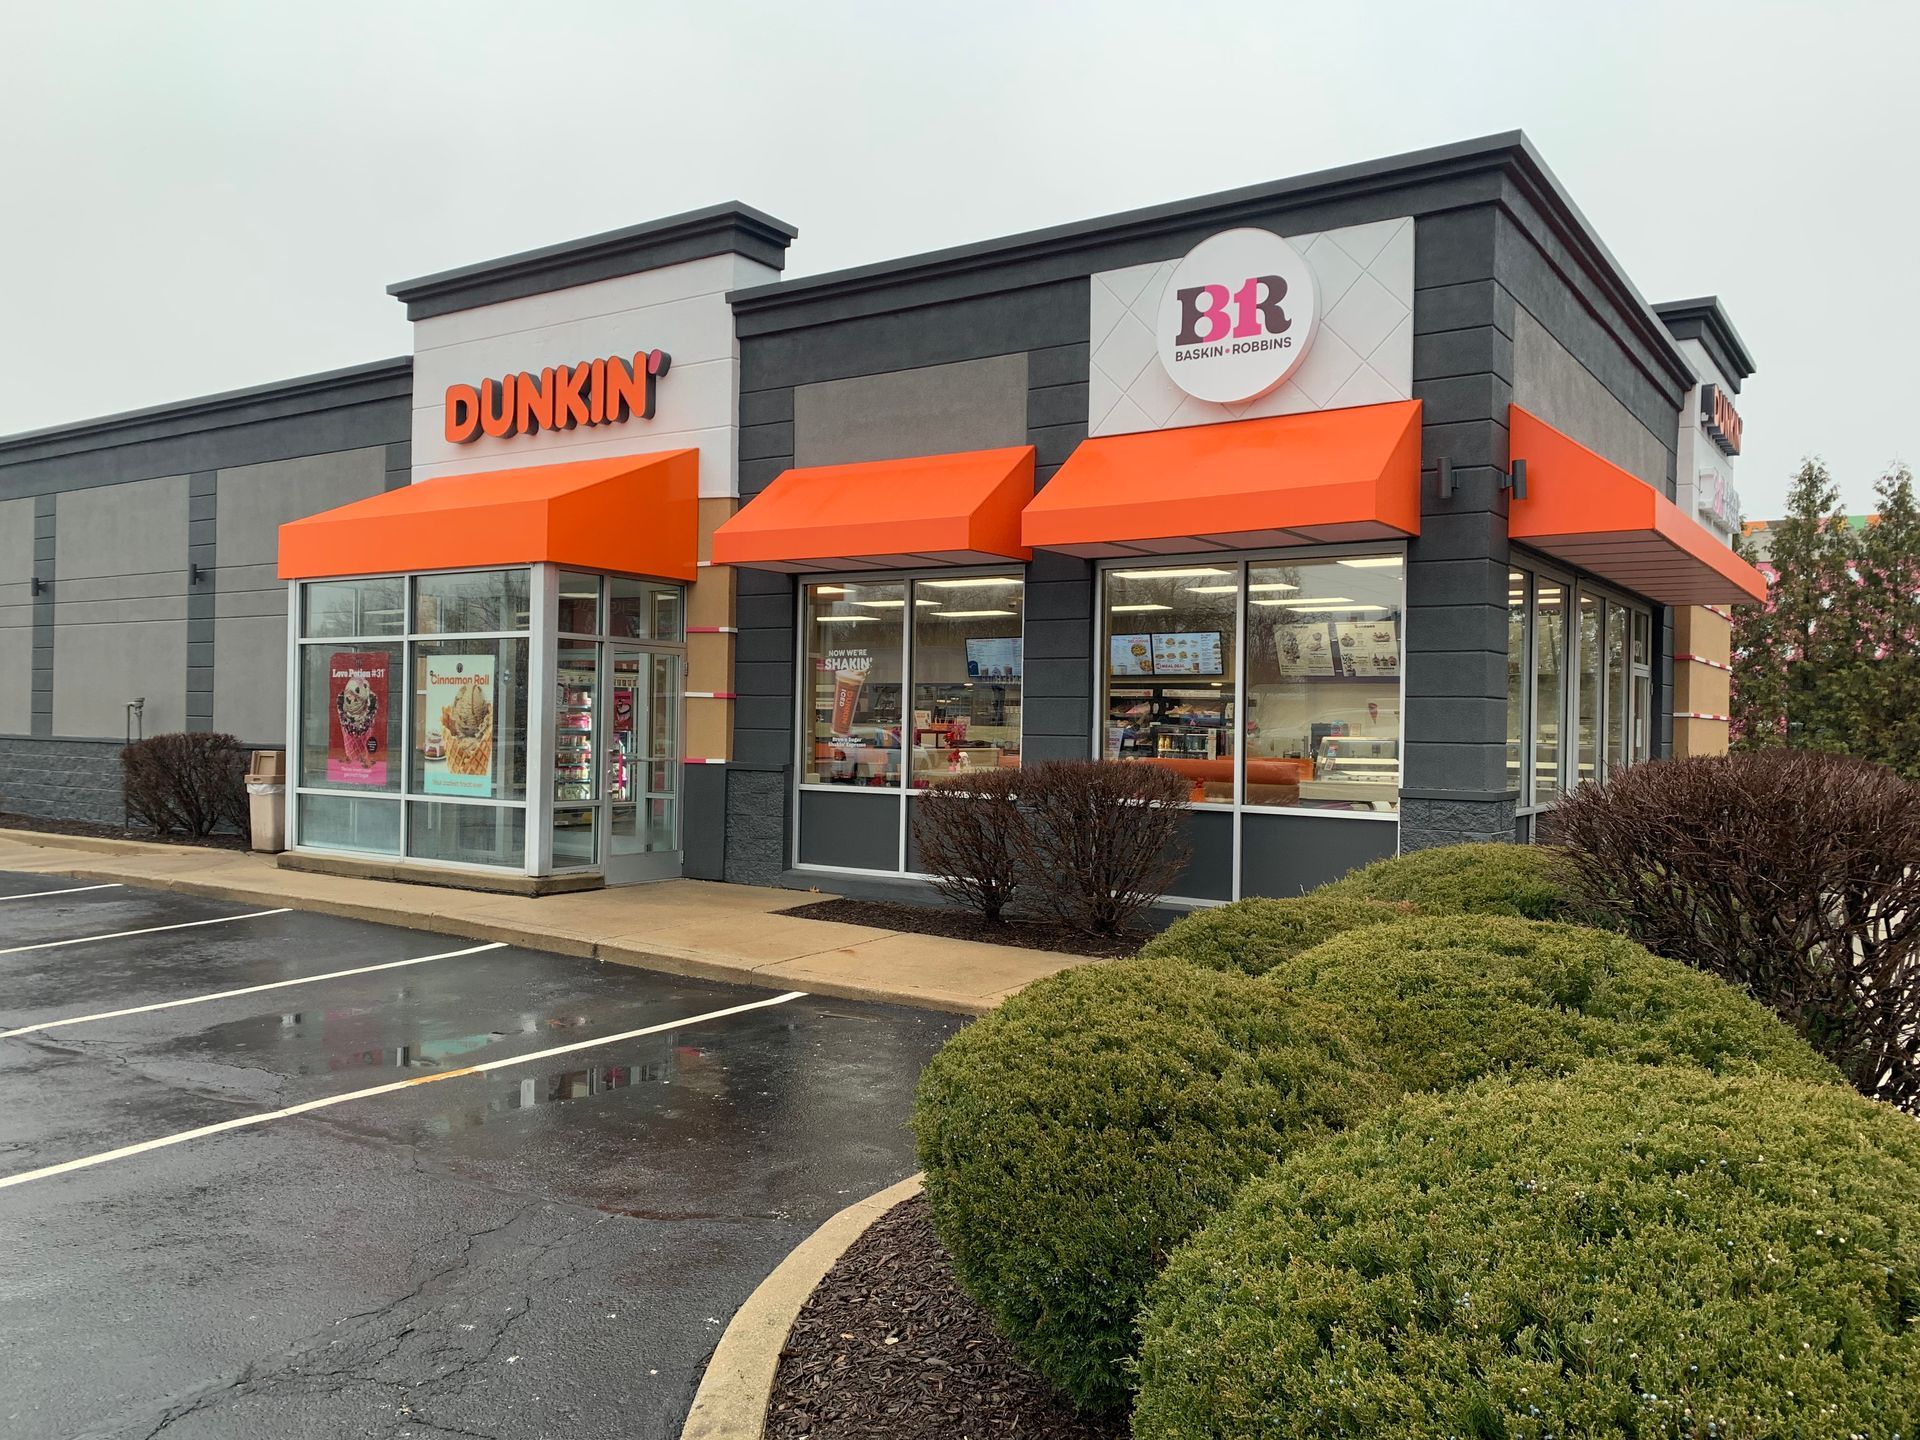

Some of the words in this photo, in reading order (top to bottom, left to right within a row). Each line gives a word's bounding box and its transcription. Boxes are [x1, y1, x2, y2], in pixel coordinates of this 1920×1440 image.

[1232, 336, 1292, 355] ROBBINS
[445, 348, 671, 444] DUNKIN'
[825, 657, 873, 670] SHAKIN'
[332, 668, 348, 678] Love
[349, 668, 371, 678] Potion
[431, 674, 473, 685] Cinnamon
[474, 674, 489, 685] Roll
